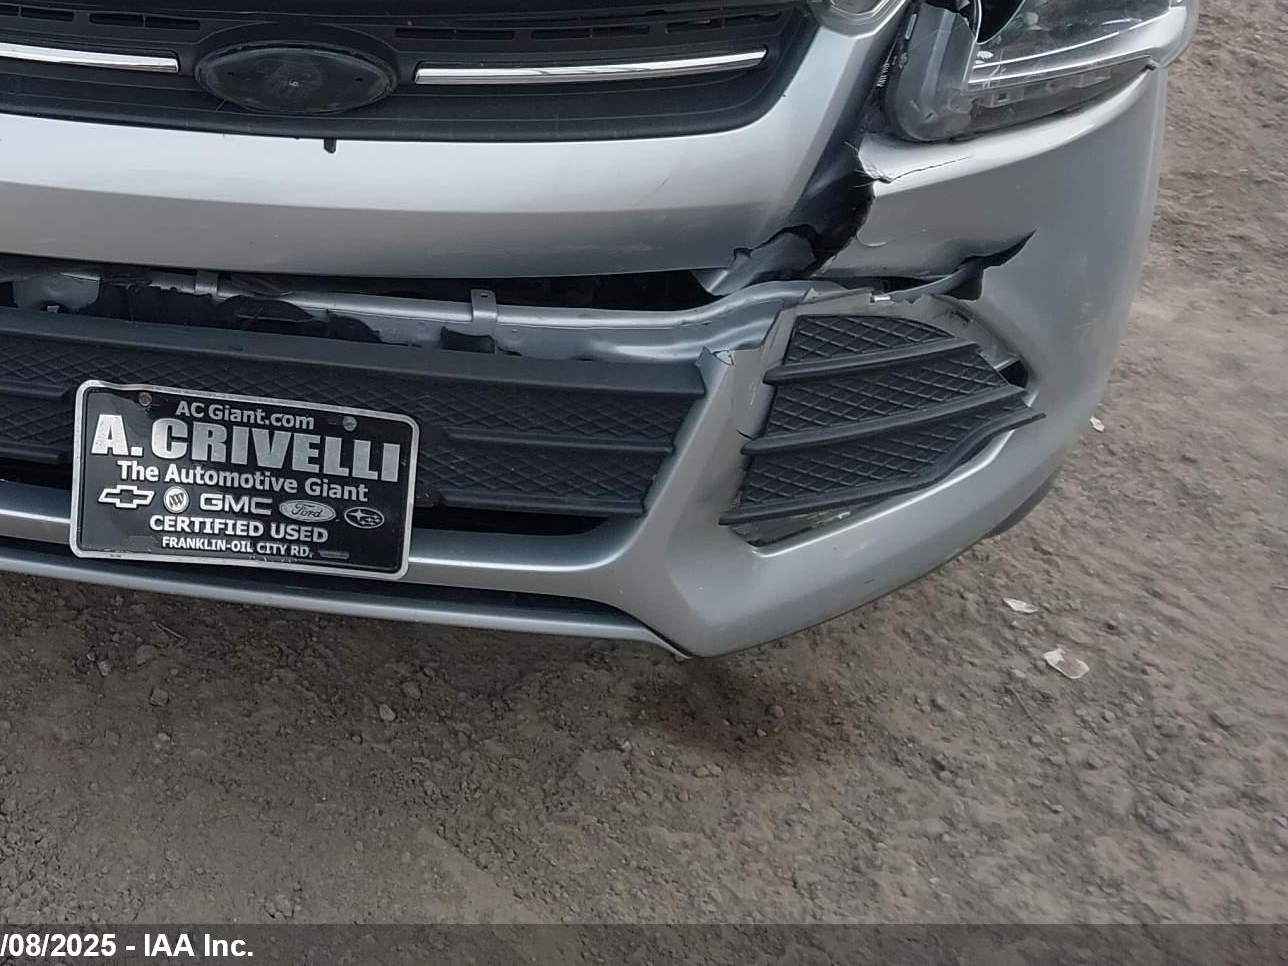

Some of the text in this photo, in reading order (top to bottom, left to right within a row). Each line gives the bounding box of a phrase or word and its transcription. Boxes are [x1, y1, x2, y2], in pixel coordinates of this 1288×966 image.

[91, 414, 401, 483] A. CRIVELLI
[117, 460, 368, 503] The Automotive Giant
[199, 492, 323, 519] GMC Ford
[149, 514, 329, 544] CERTIFIED USED
[162, 536, 314, 558] FRANKLIN-OIL CITY RD.
